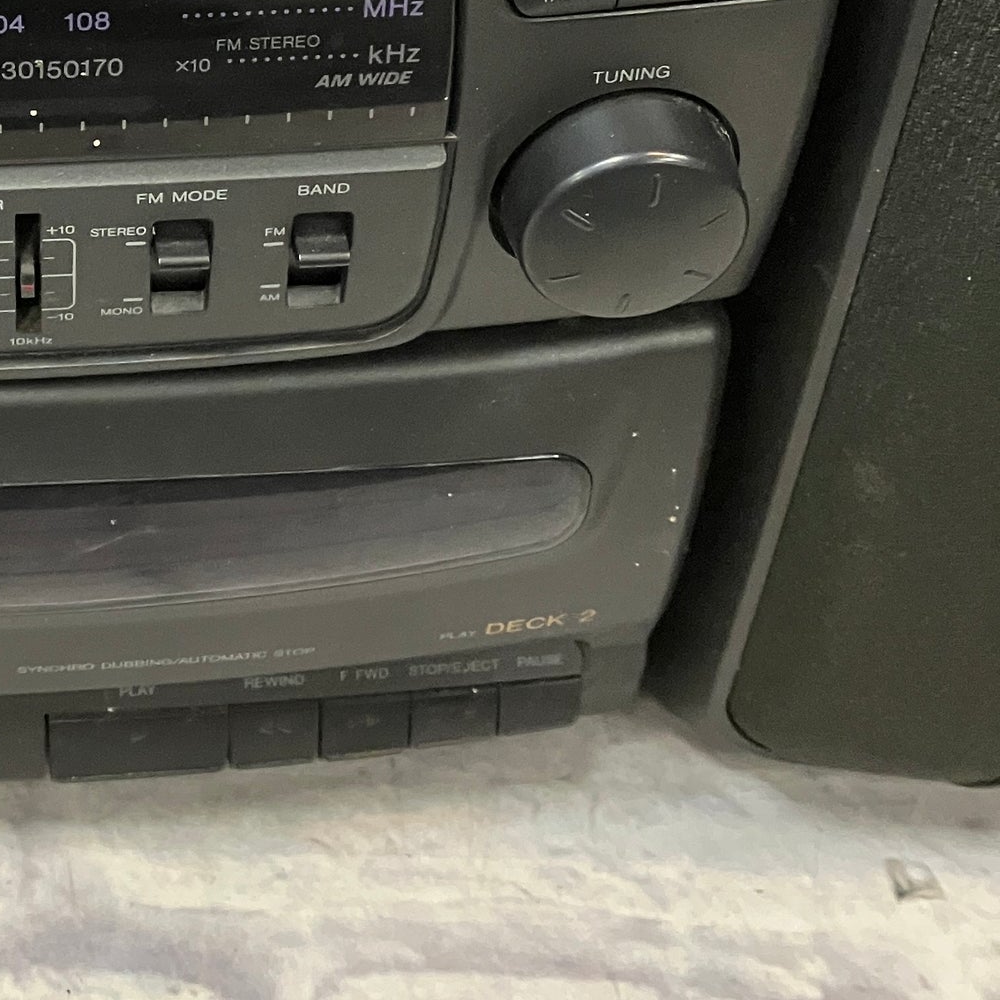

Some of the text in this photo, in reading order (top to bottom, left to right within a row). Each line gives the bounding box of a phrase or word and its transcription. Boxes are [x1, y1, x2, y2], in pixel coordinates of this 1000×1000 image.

[64, 11, 111, 32] 108
[216, 34, 321, 52] FM STEREO
[368, 43, 421, 65] kHz
[34, 59, 80, 79] 150
[80, 57, 124, 77] 170
[593, 65, 671, 85] TUNING
[314, 71, 413, 88] AM WIDE
[136, 189, 229, 205] FM MODE
[297, 183, 351, 197] BAND
[46, 225, 76, 236] +10
[90, 226, 147, 238] STEREO
[264, 227, 286, 238] FM
[260, 293, 281, 303] AM
[47, 312, 75, 322] -10
[100, 306, 144, 317] MONO
[9, 336, 53, 347] 10kHz
[485, 613, 568, 635] DECK
[579, 608, 597, 623] 2
[118, 685, 156, 697] PLAY
[243, 673, 306, 689] REWIND
[355, 667, 390, 681] FWD
